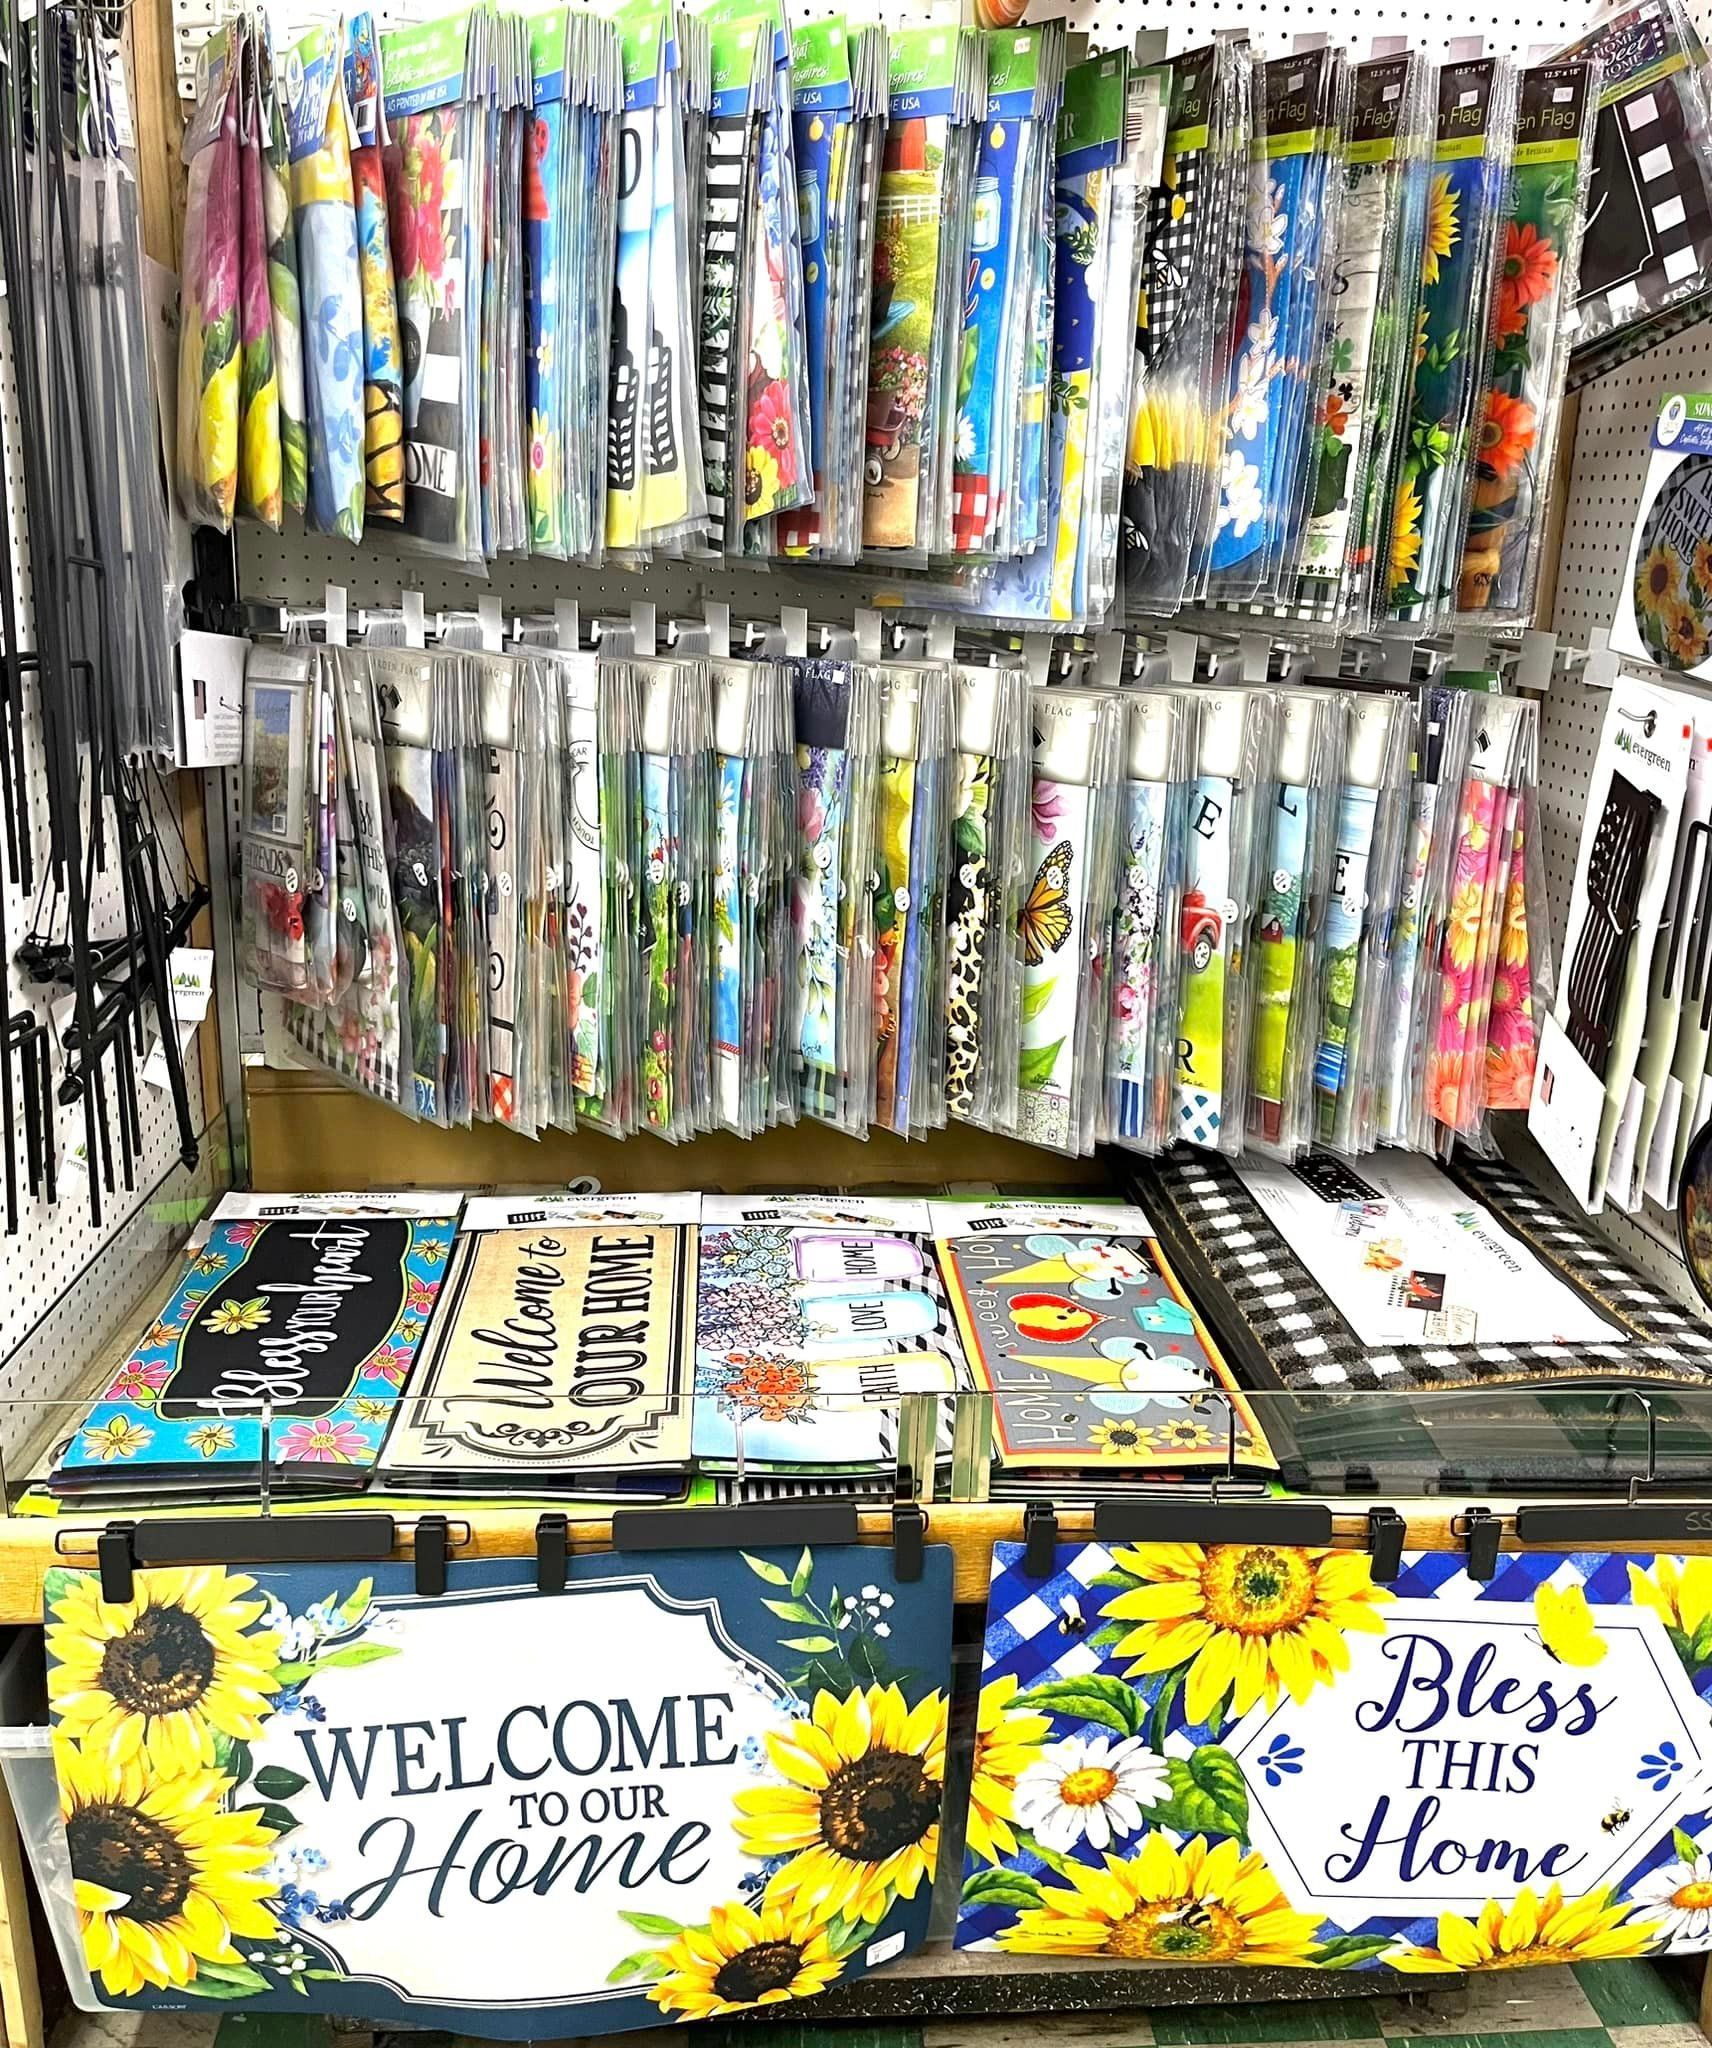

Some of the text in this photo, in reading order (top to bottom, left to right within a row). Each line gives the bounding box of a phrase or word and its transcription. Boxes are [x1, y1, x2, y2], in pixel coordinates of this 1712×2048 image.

[533, 83, 543, 96] SA
[626, 89, 635, 102] SA
[713, 97, 722, 110] SA
[803, 95, 822, 105] USA
[901, 97, 921, 110] USA
[988, 101, 1000, 112] SA
[1278, 101, 1307, 121] Flag
[1363, 107, 1393, 128] Flag
[1451, 106, 1482, 126] Flag
[1541, 107, 1575, 130] Flag
[805, 667, 831, 680] FLAG
[1044, 703, 1072, 717] FLAG
[1631, 742, 1671, 772] evergreen
[796, 1196, 865, 1204] evergreen
[1014, 1203, 1083, 1211] evergreen
[256, 1220, 373, 1292] heart
[840, 1239, 878, 1275] HOME
[1471, 1229, 1523, 1273] evergreen
[582, 1234, 654, 1316] HOME
[442, 1235, 567, 1413] Welcome to
[848, 1300, 888, 1332] LOVE
[967, 1287, 1018, 1349] sweet
[568, 1320, 650, 1408] OUR
[857, 1363, 899, 1403] FAITH
[996, 1370, 1077, 1444] HOME
[1355, 1633, 1618, 1737] Bless
[294, 1692, 739, 1801] WELCOME
[1402, 1739, 1539, 1795] THIS
[509, 1785, 669, 1830] TO OUR
[1324, 1795, 1588, 1884] Home
[346, 1807, 712, 1922] Home
